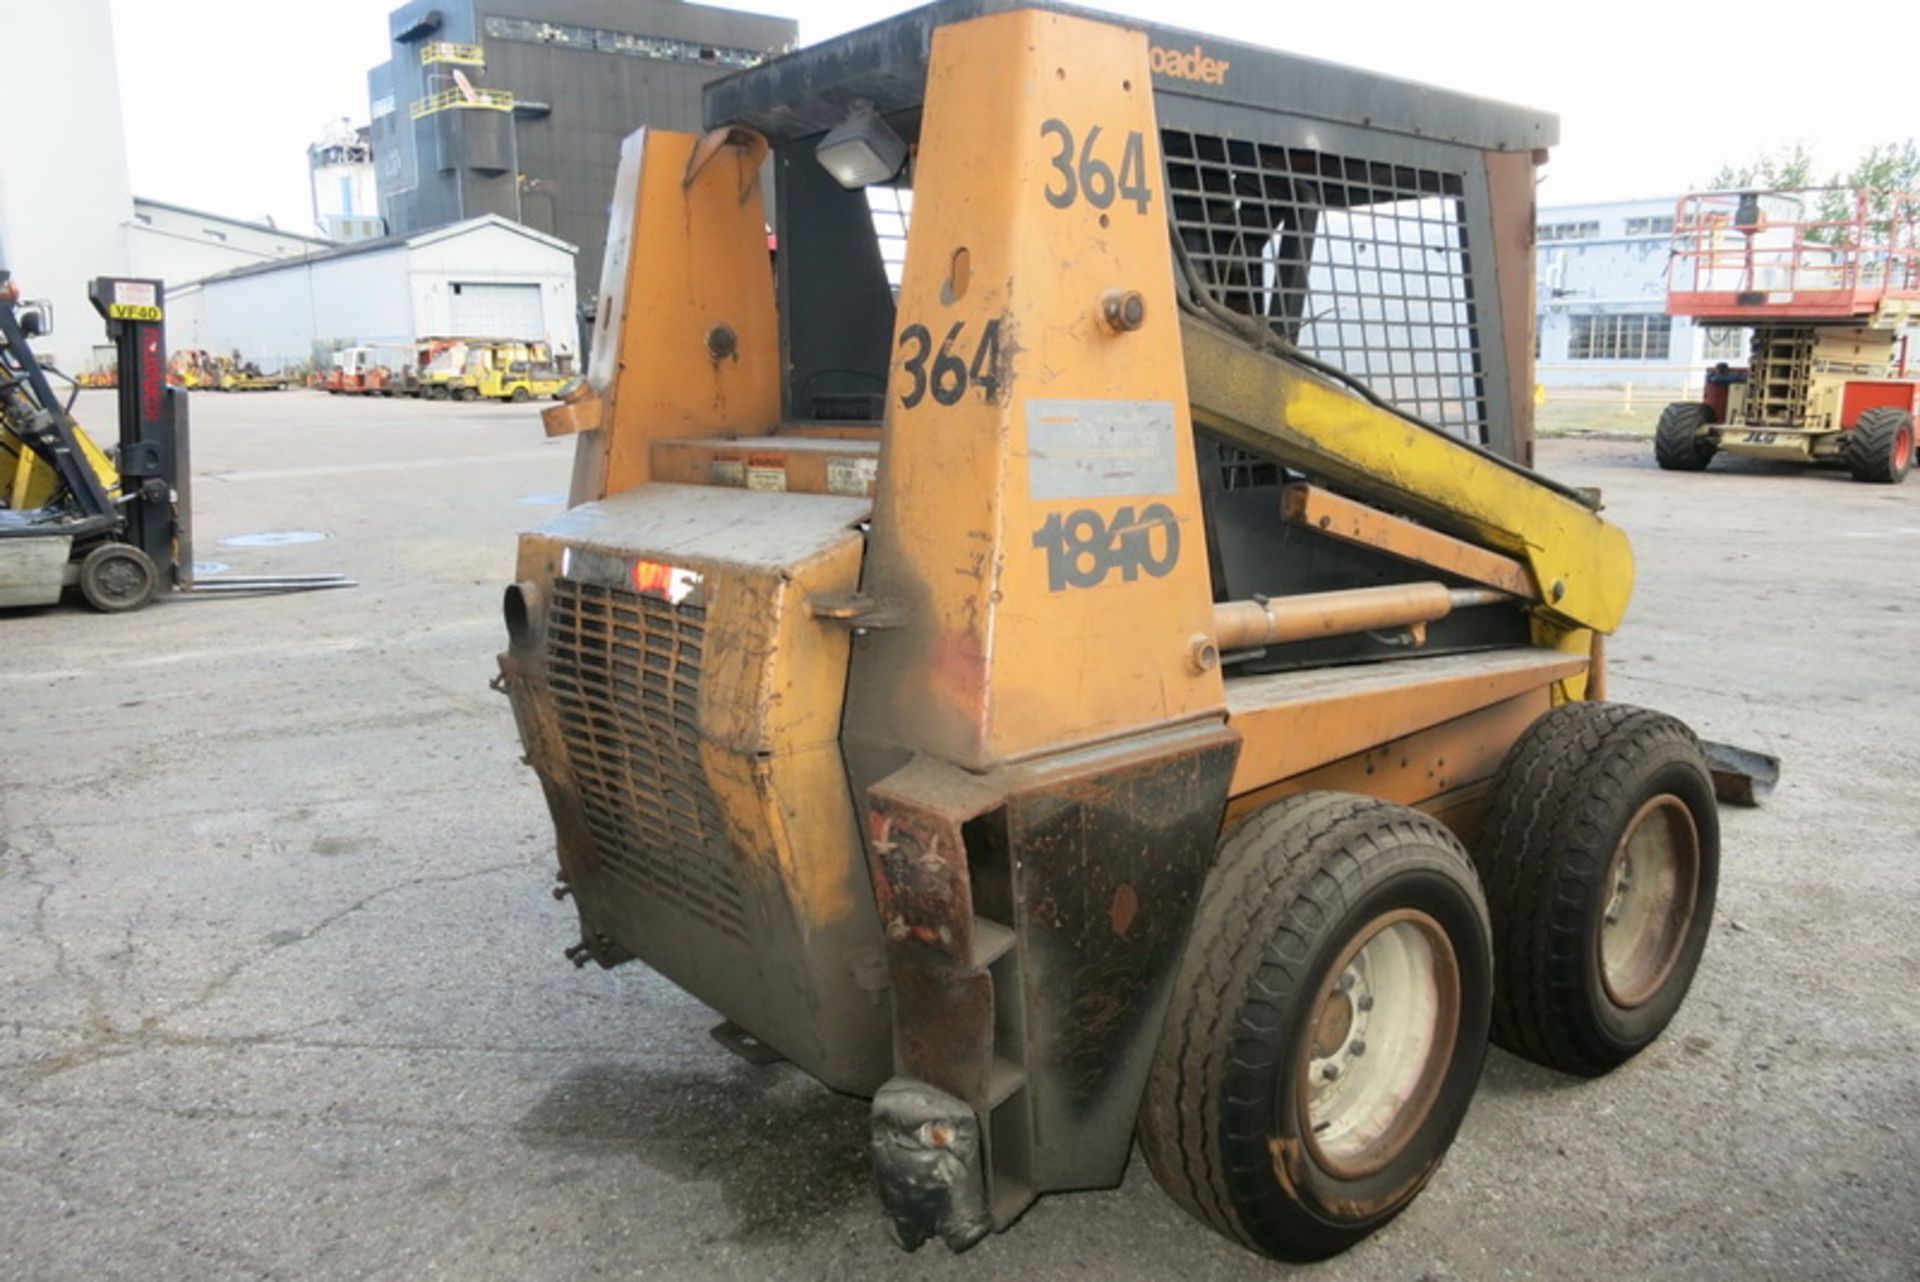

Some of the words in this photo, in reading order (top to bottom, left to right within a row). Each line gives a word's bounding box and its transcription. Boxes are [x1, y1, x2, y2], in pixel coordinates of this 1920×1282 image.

[1151, 44, 1230, 86] oader
[1041, 118, 1152, 216] 364
[115, 304, 158, 319] VF40
[899, 318, 1002, 410] 364
[1742, 431, 1777, 444] JLG
[1031, 502, 1181, 593] 1840
